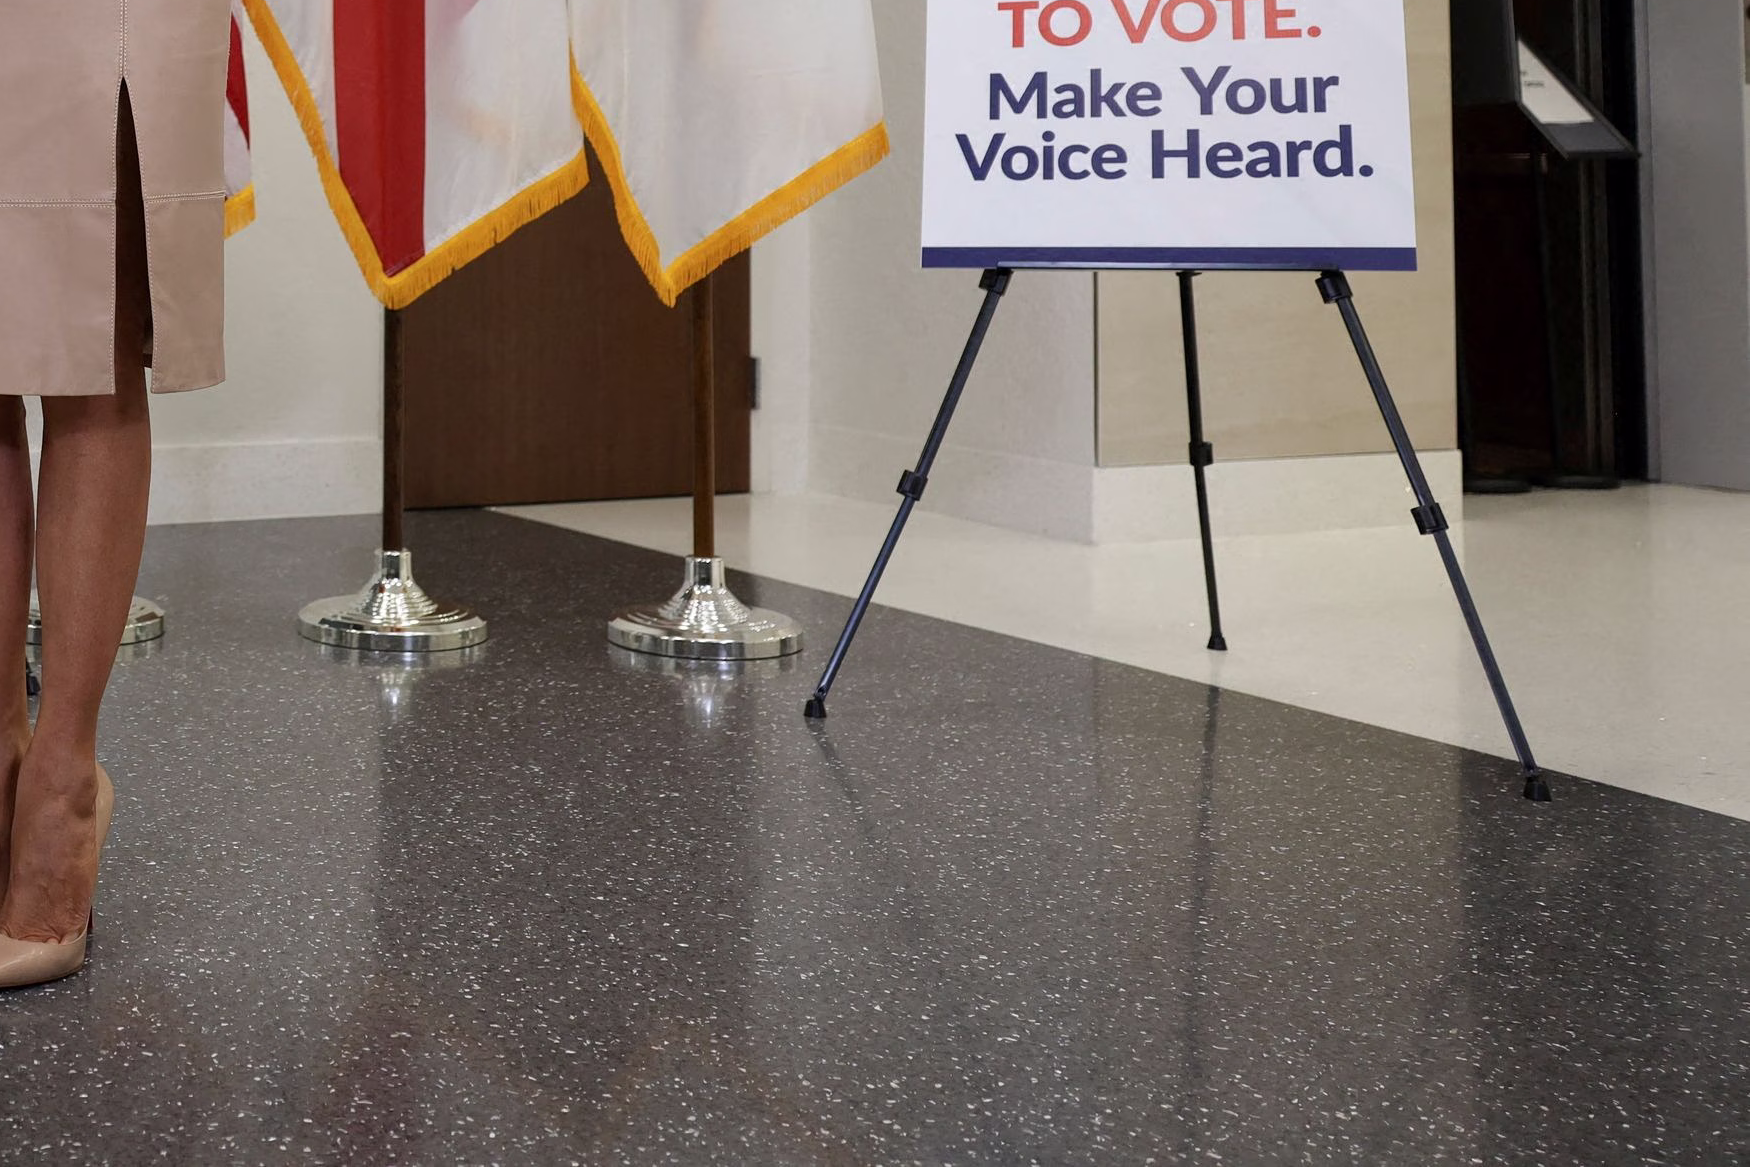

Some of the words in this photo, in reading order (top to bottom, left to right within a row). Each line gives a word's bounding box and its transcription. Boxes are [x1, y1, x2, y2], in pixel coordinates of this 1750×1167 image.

[989, 68, 1162, 121] Make
[1182, 65, 1339, 116] Your
[955, 130, 1128, 181] Voice
[1151, 124, 1374, 180] Heard.
